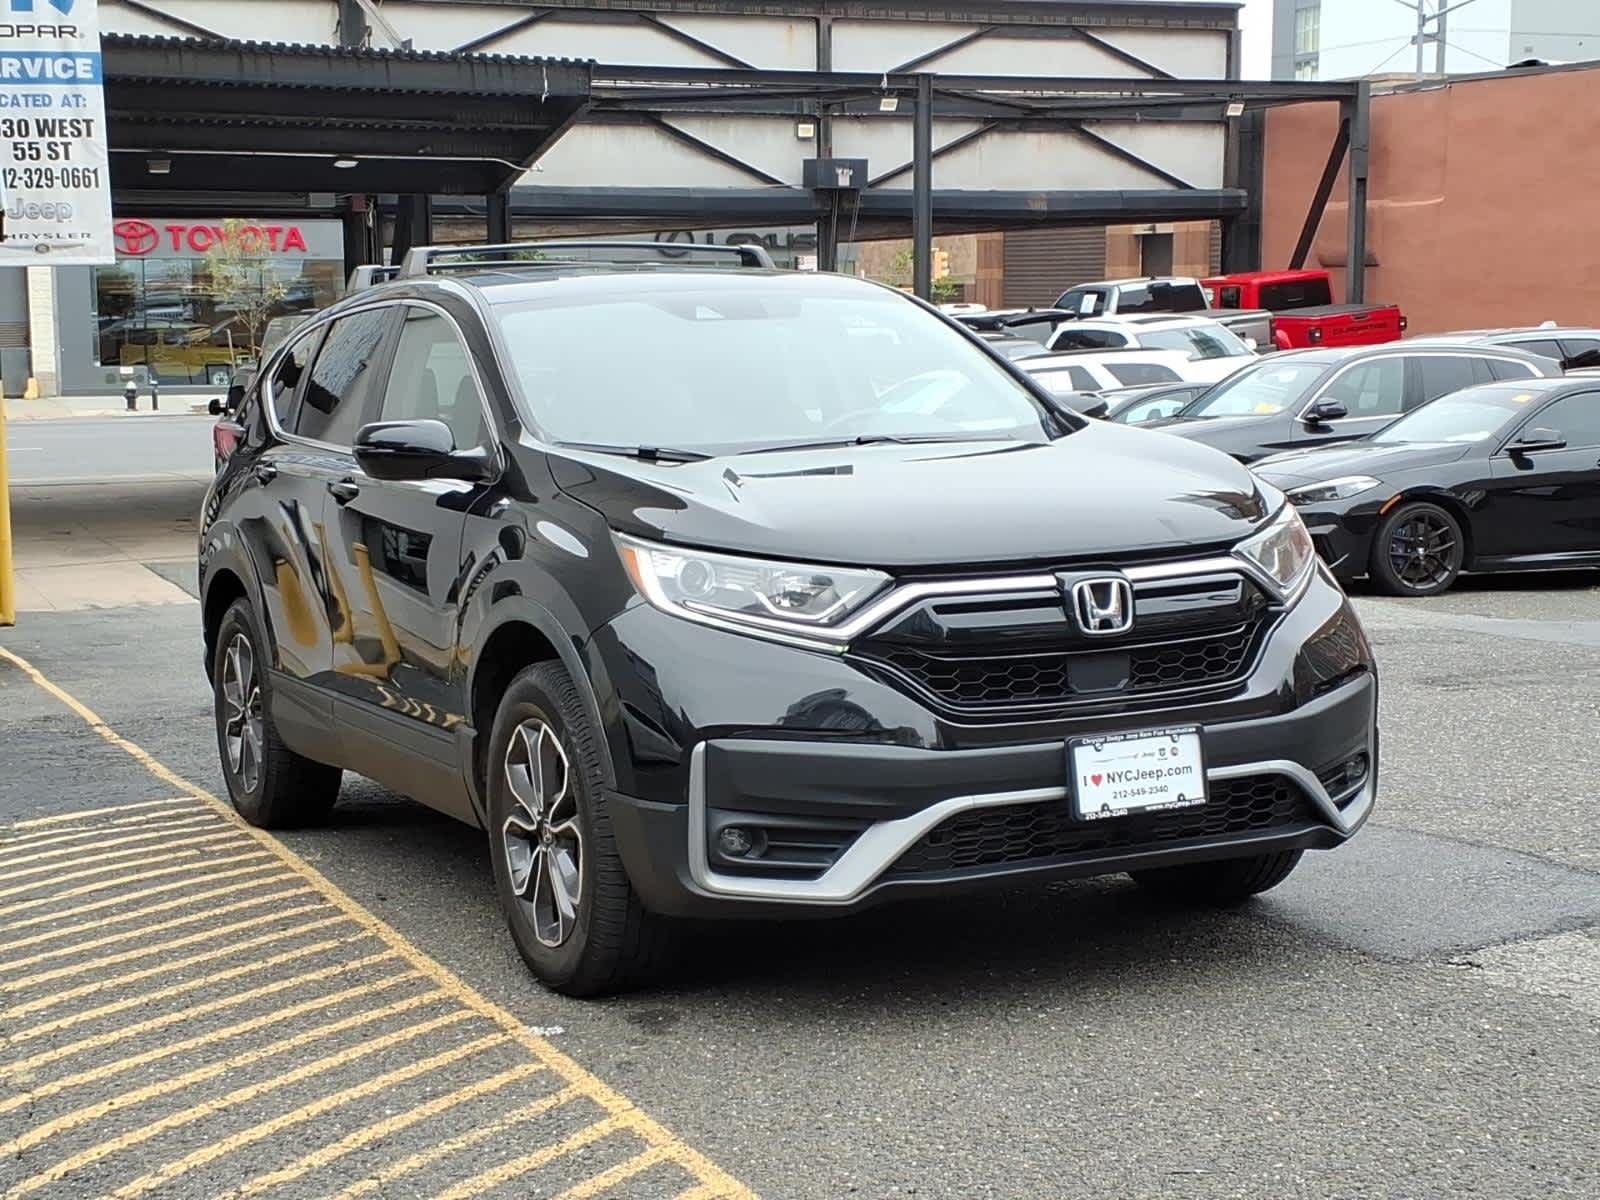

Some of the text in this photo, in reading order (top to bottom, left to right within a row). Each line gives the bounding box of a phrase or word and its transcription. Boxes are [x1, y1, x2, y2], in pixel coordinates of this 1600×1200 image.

[0, 25, 77, 38] OPAR
[0, 58, 94, 79] RVICE
[0, 94, 87, 108] CATED AT:
[0, 118, 94, 138] 30 WEST
[13, 141, 72, 161] 55 ST
[2, 167, 99, 189] 12-329-0661
[7, 197, 73, 223] Jeep
[4, 232, 91, 240] HRYSLER
[165, 225, 307, 252] TOYOTA
[1106, 765, 1193, 785] NYCJeep.com
[1112, 785, 1169, 799] 212-549-2340
